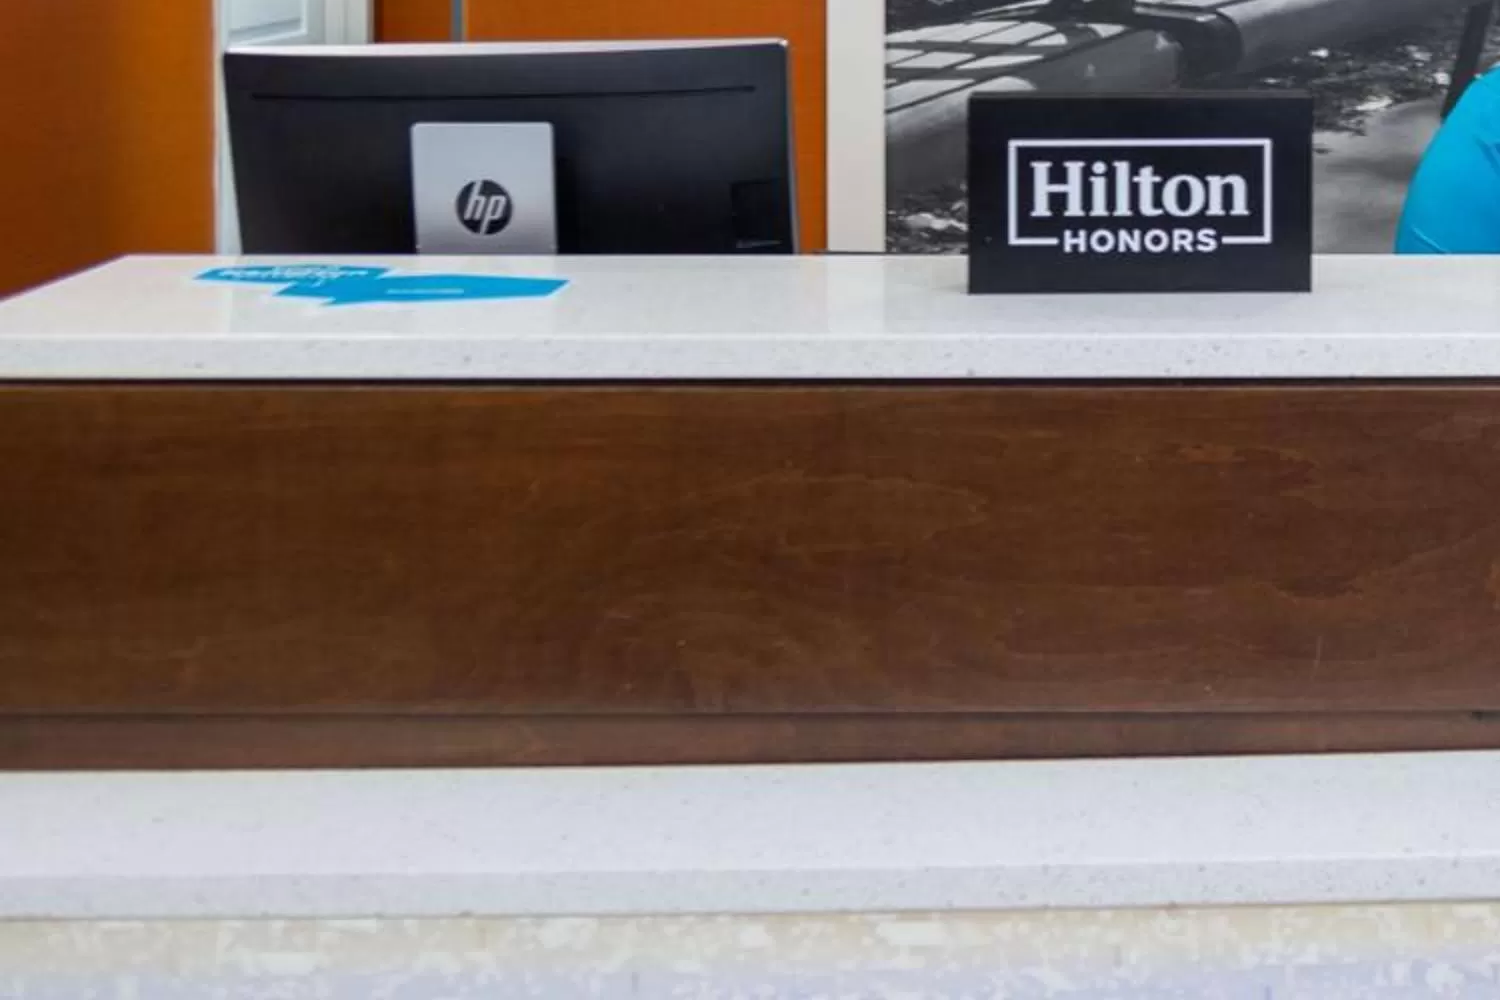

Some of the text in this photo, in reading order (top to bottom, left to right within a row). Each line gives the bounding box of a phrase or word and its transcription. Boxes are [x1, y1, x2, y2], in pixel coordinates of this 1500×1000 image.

[463, 180, 508, 235] hp
[1030, 160, 1251, 218] Hilton
[1063, 229, 1218, 253] HONORS
